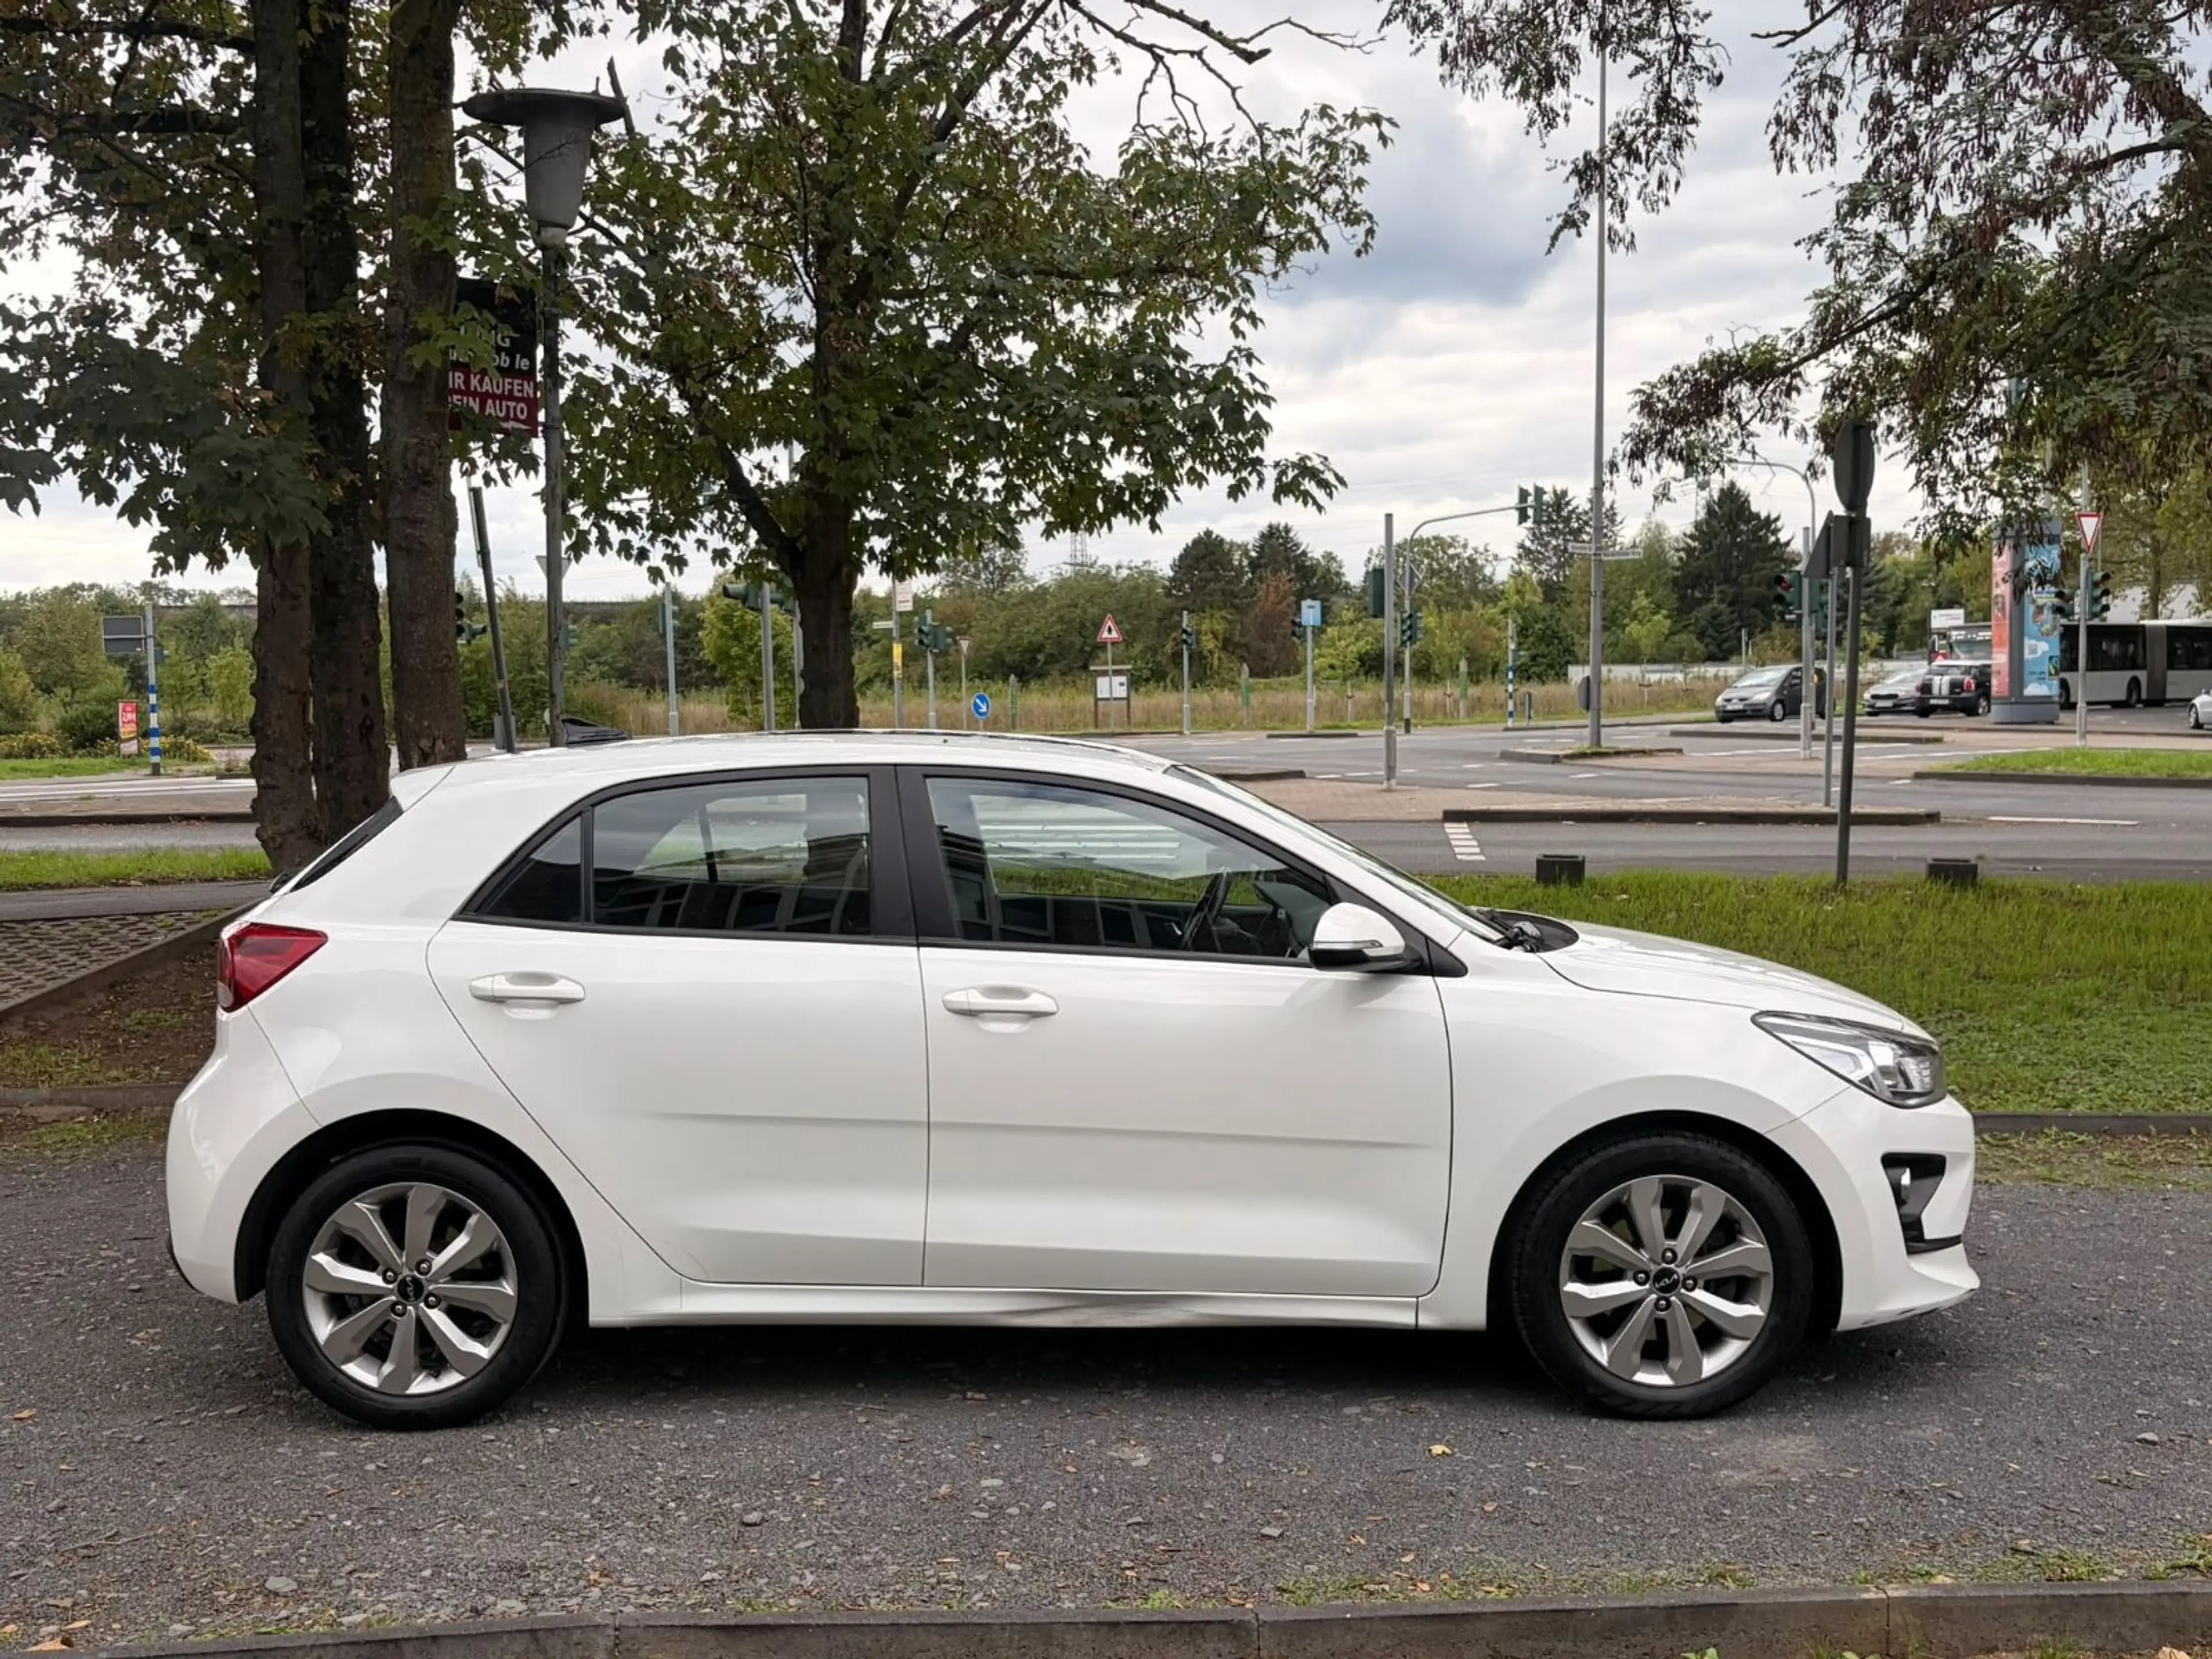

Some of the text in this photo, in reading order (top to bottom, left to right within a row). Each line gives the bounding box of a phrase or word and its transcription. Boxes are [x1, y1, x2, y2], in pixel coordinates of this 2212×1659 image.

[448, 371, 535, 399] IR KAUFEN
[484, 398, 528, 420] AUTO
